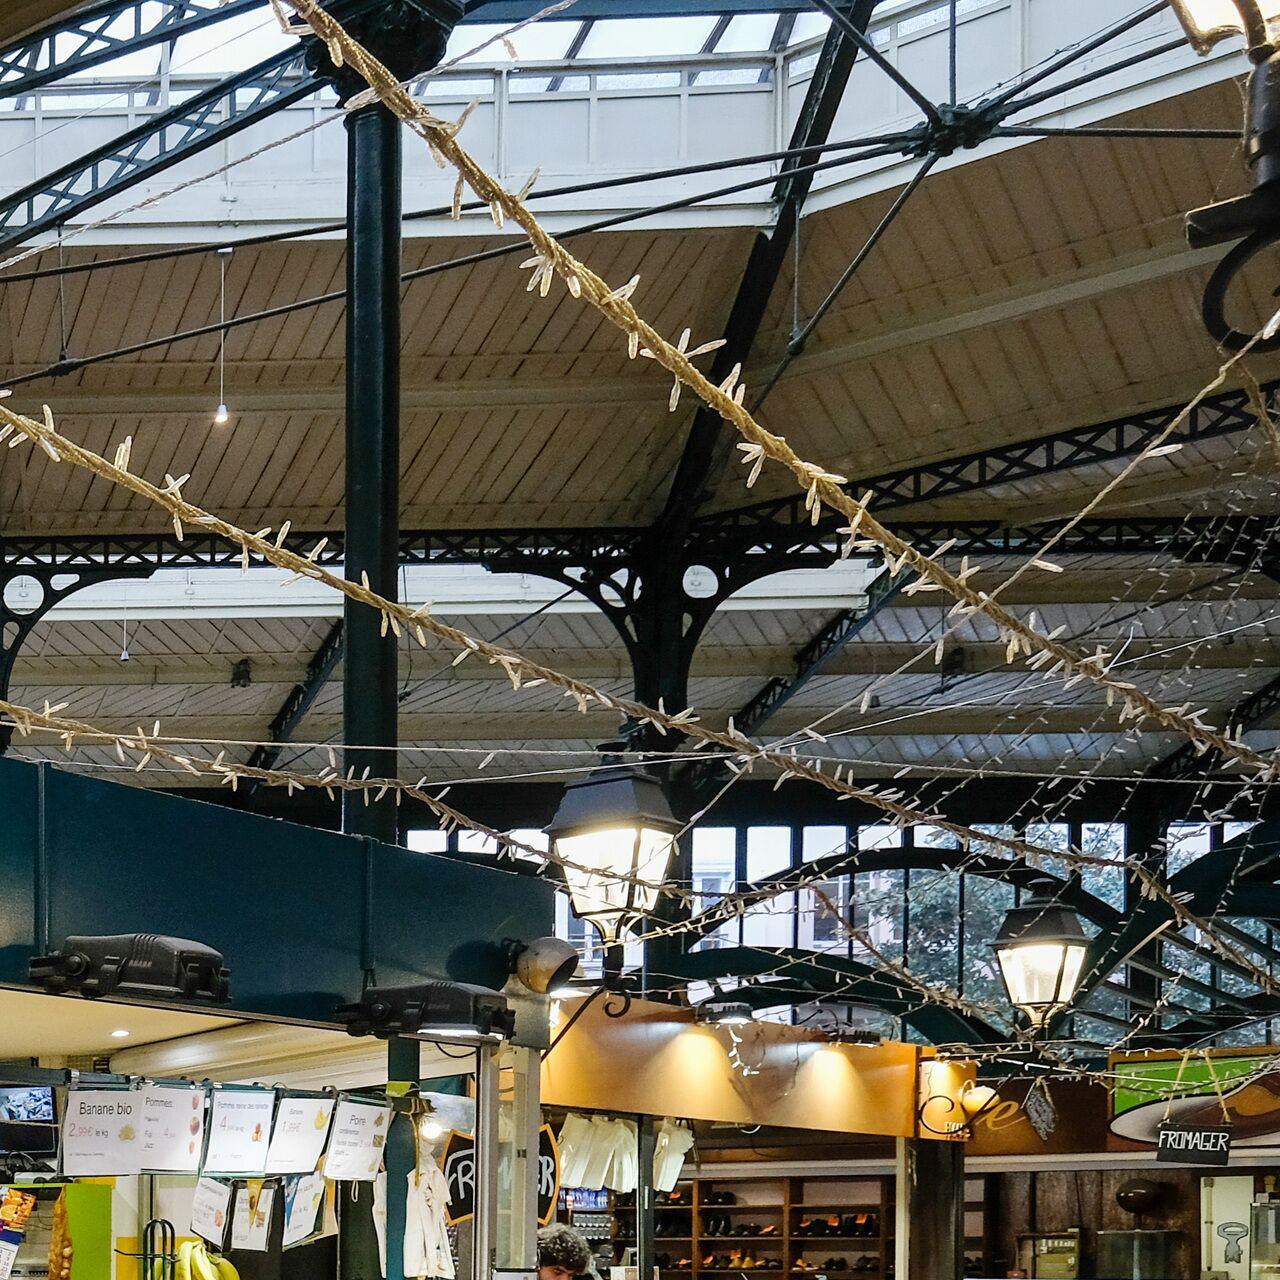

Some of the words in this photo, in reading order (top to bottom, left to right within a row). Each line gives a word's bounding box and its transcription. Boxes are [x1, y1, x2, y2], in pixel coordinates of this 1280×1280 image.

[80, 1102, 114, 1115] Banane
[117, 1102, 133, 1115] bio
[349, 1114, 366, 1126] Poire
[101, 1129, 109, 1138] kg
[1158, 1131, 1230, 1151] FROMAGER
